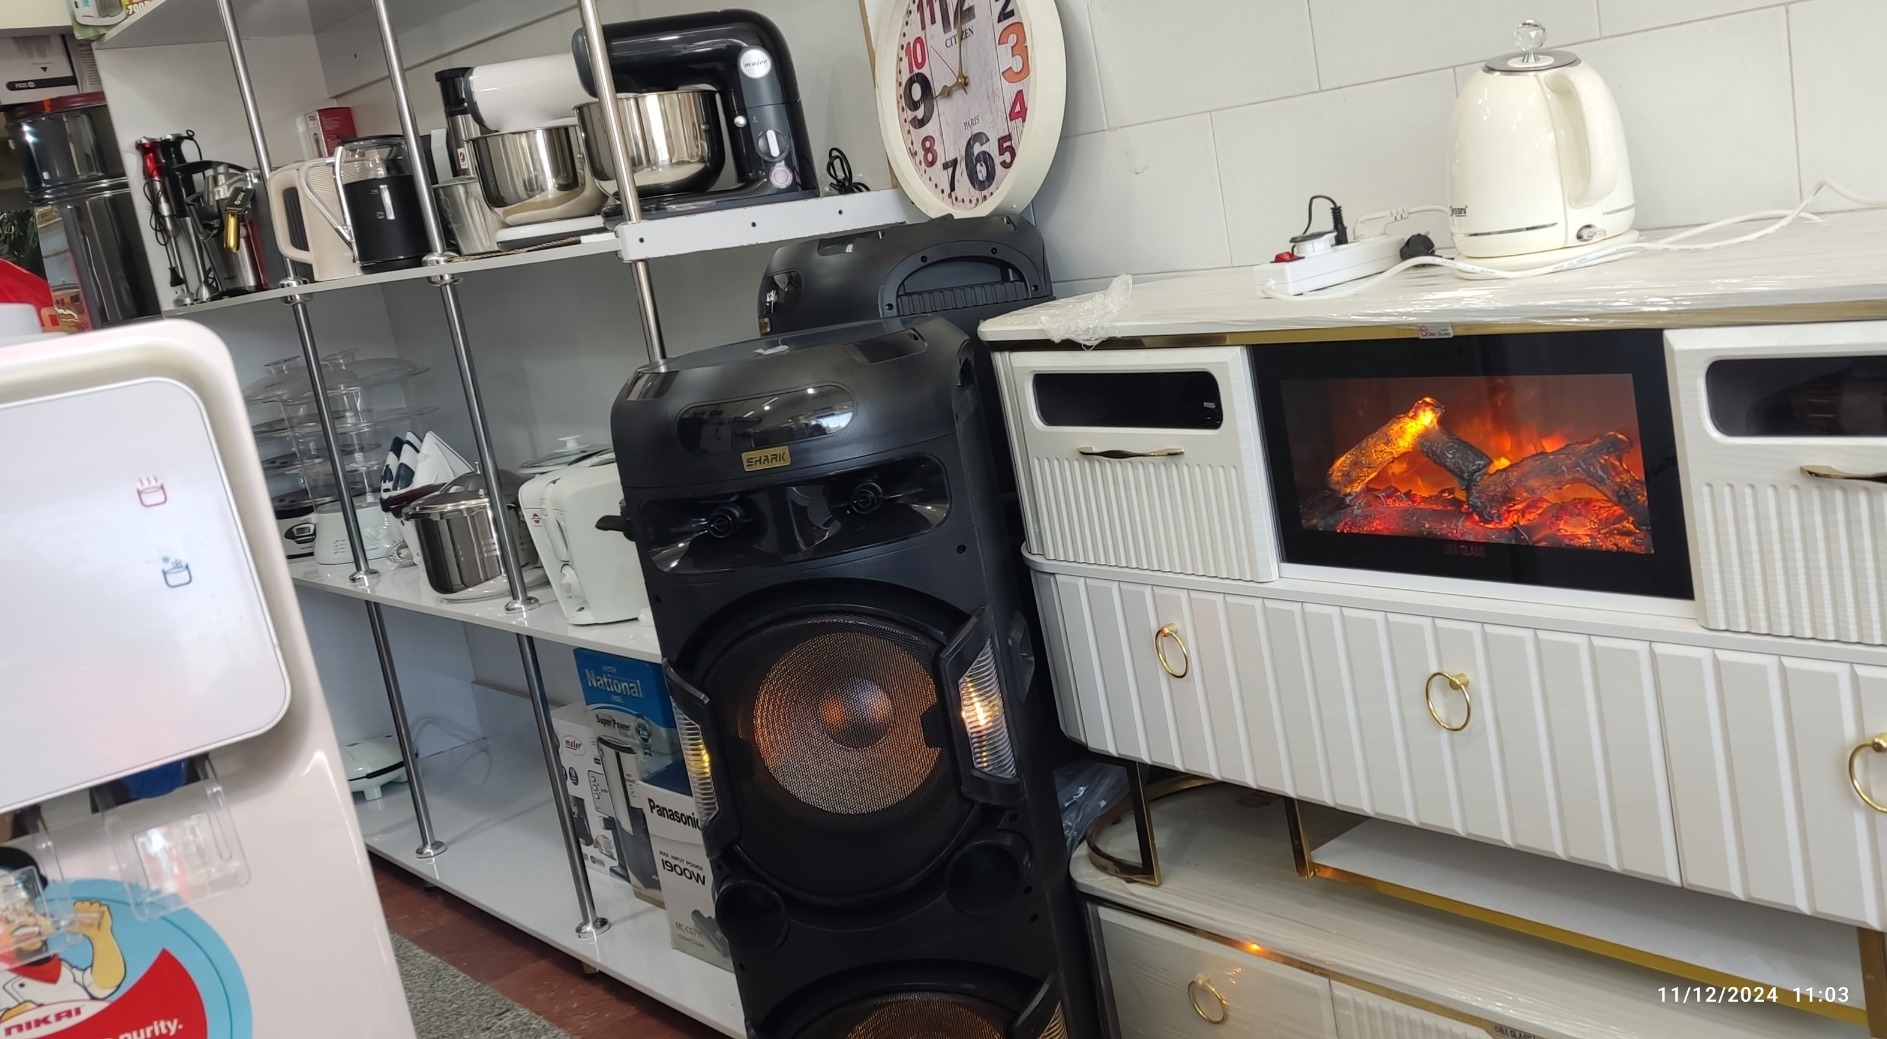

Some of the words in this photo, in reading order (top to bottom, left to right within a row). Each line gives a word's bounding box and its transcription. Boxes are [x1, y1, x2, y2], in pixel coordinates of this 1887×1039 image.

[916, 0, 937, 32] 11
[996, 0, 1016, 24] 2
[944, 26, 975, 49] CITZEN
[997, 21, 1031, 84] 3
[904, 36, 927, 75] 10
[903, 72, 935, 130] 9
[1008, 89, 1028, 124] 4
[963, 115, 980, 131] PARIS
[921, 135, 939, 168] 8
[964, 131, 997, 192] 6
[997, 133, 1017, 170] 5
[942, 157, 959, 193] 7
[746, 452, 786, 467] SHARK
[584, 668, 643, 698] National
[596, 714, 612, 727] Super
[612, 719, 630, 731] Power
[661, 858, 706, 886] 1900W
[686, 860, 704, 871] POWER
[118, 1018, 184, 1039] purity.
